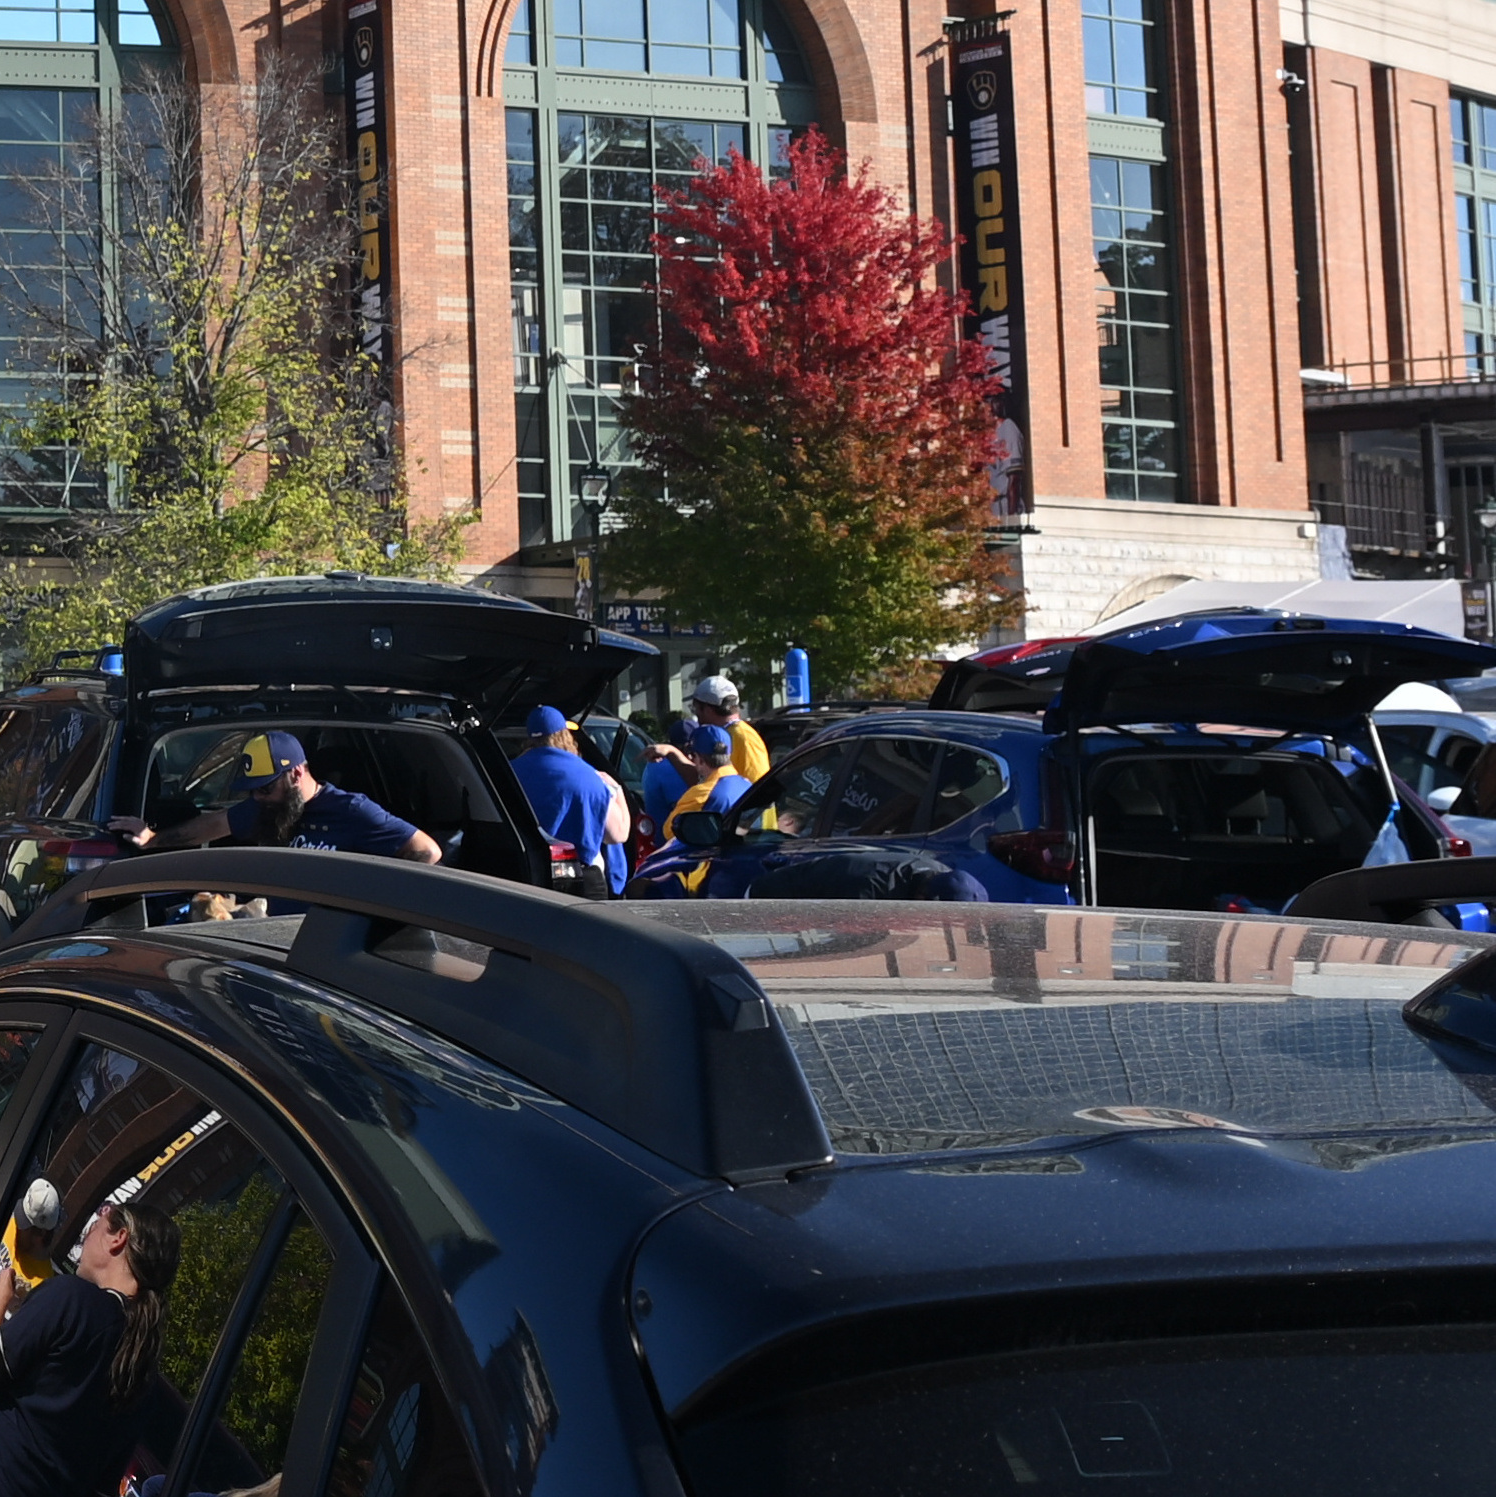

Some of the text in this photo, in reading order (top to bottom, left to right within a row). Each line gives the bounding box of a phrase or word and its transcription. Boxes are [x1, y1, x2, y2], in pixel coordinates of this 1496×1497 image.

[355, 71, 376, 129] WIN
[969, 113, 1000, 168] WIN
[357, 130, 380, 281] OUR
[973, 169, 1008, 315] OUR
[608, 606, 631, 621] APP
